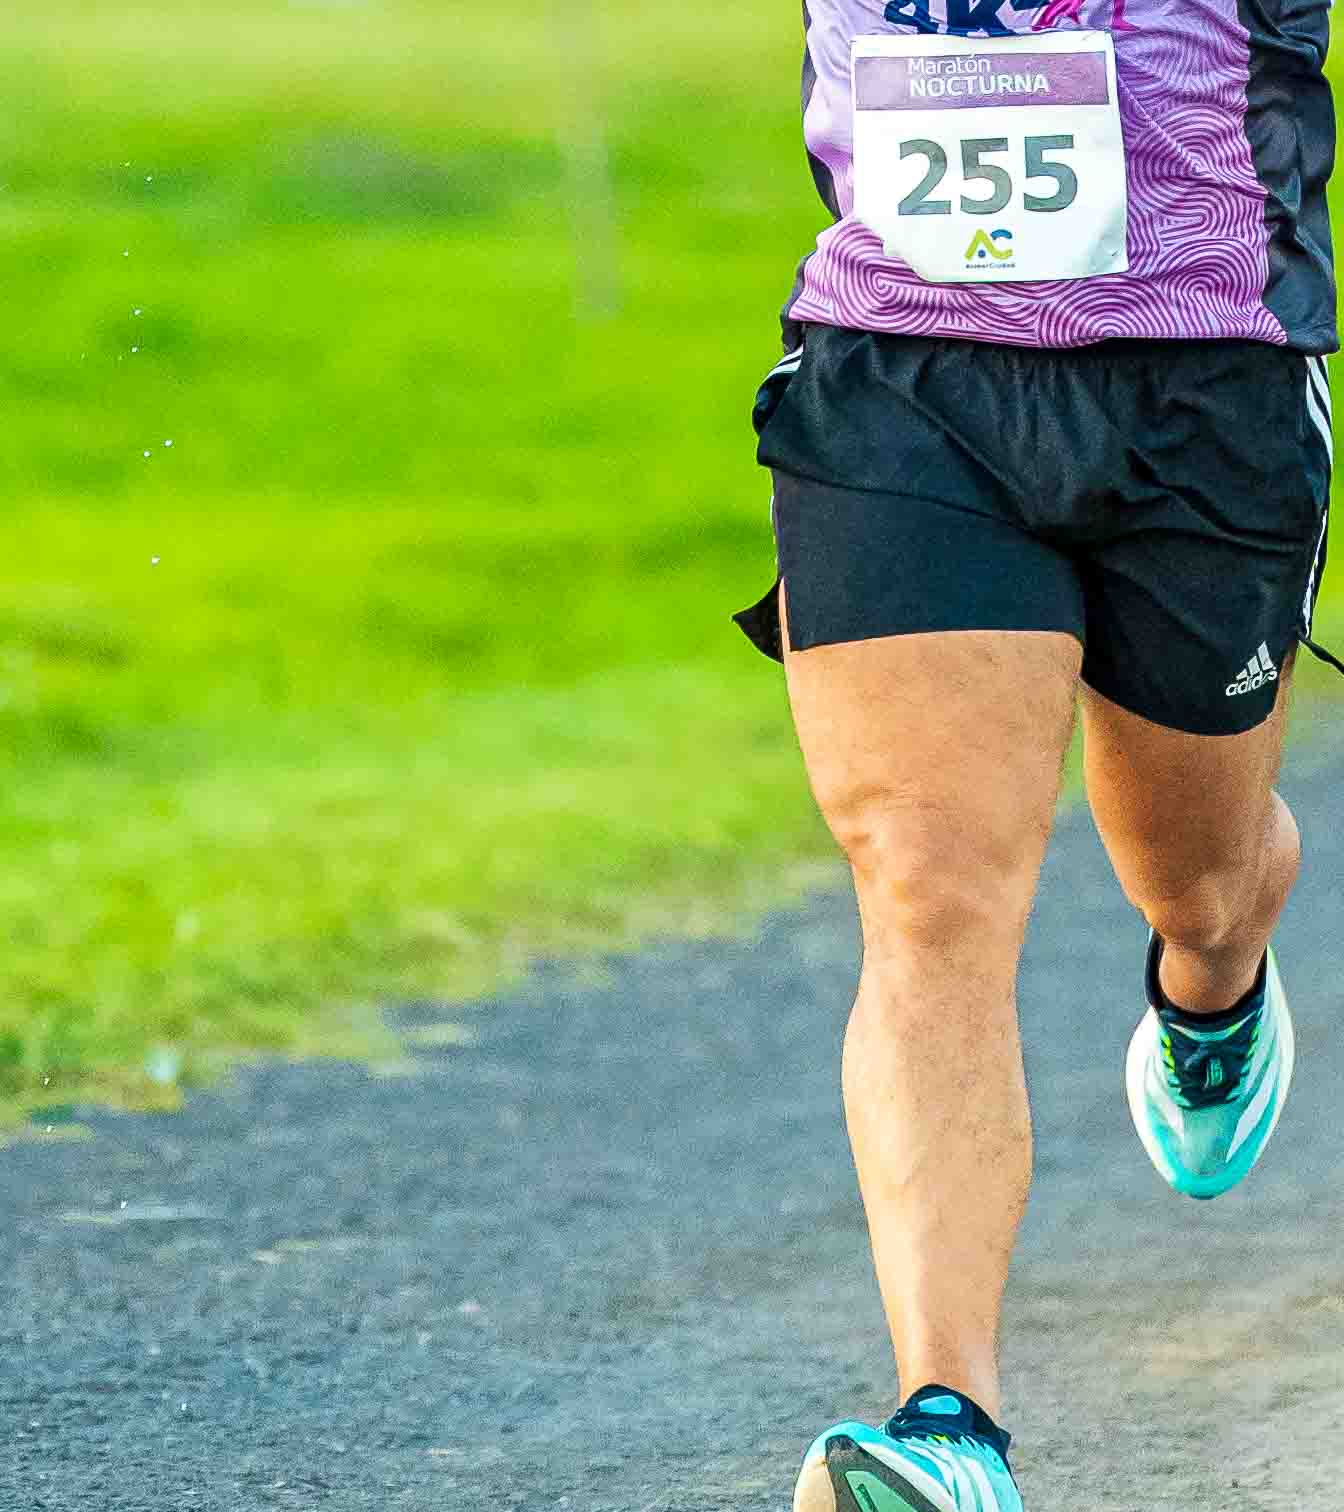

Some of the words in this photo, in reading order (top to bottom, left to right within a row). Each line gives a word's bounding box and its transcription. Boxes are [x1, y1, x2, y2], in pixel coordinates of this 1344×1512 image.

[908, 49, 992, 75] Maratón
[909, 73, 1051, 97] NOCTURNA
[898, 134, 1078, 216] 255
